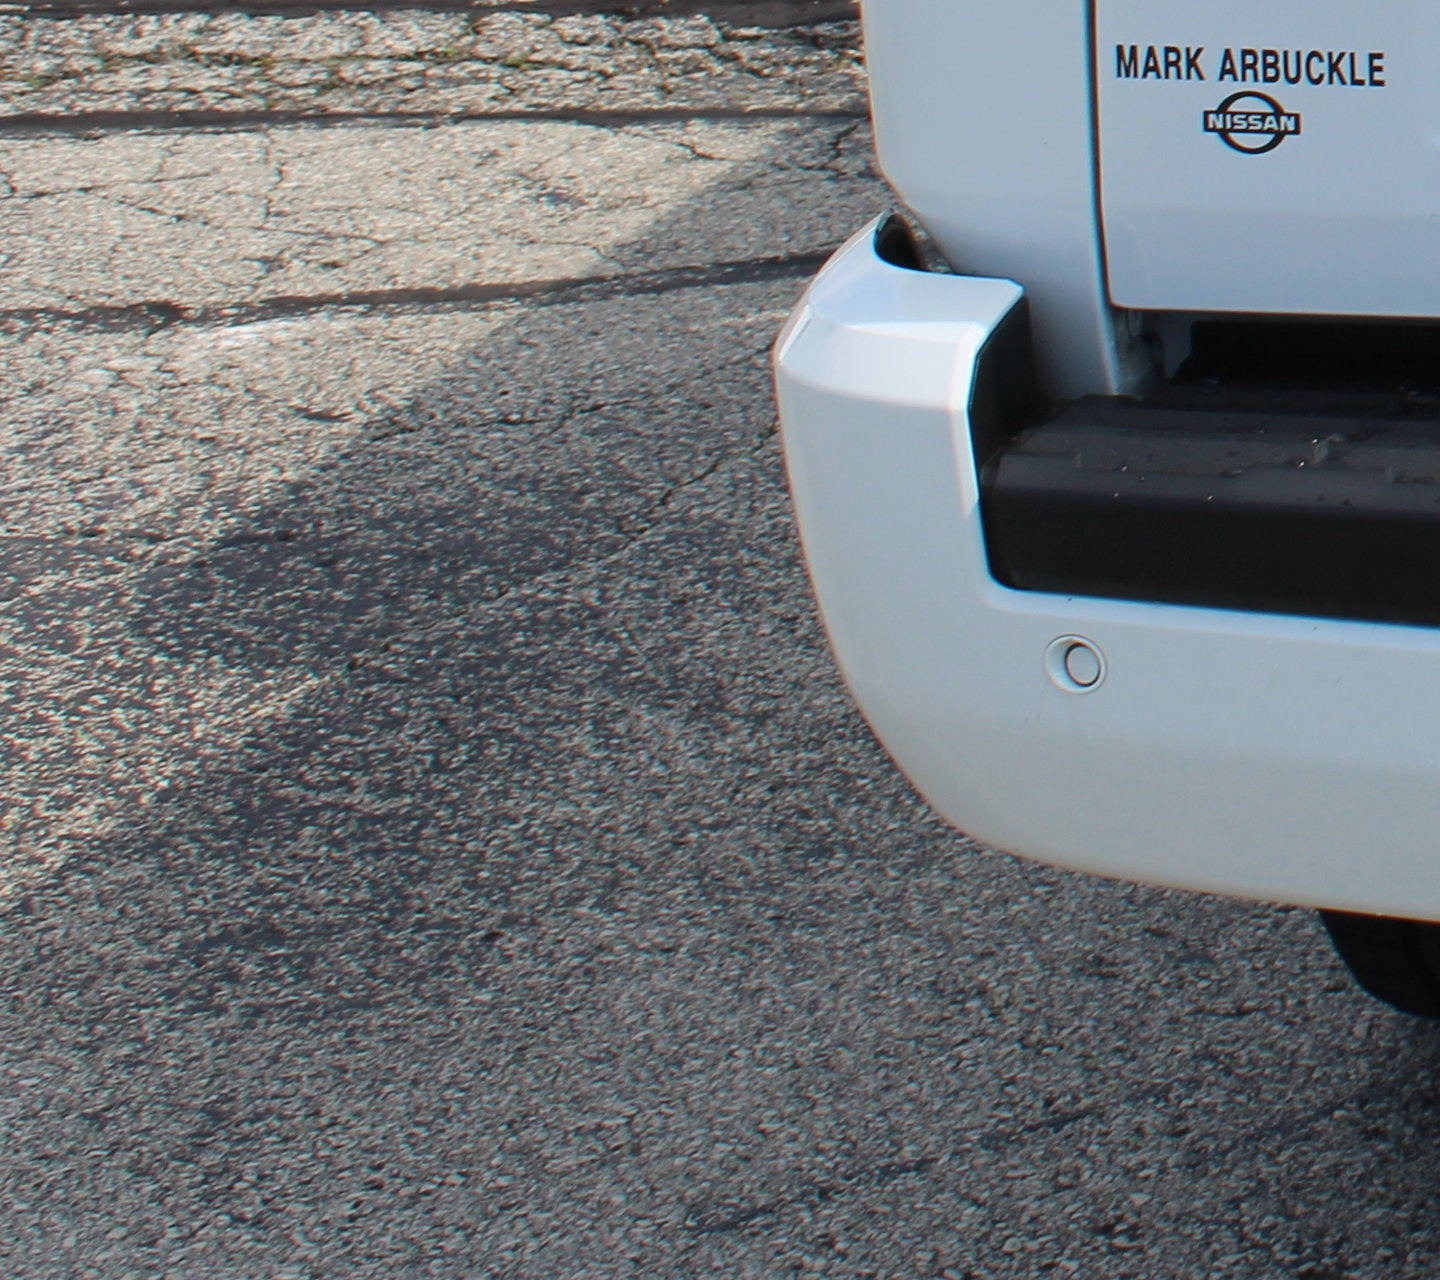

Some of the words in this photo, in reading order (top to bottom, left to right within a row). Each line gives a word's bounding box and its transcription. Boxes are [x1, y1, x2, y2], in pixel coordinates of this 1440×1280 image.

[1115, 43, 1206, 82] MARK
[1217, 47, 1387, 88] ARBUCKLE
[1206, 112, 1297, 133] NISSAN
